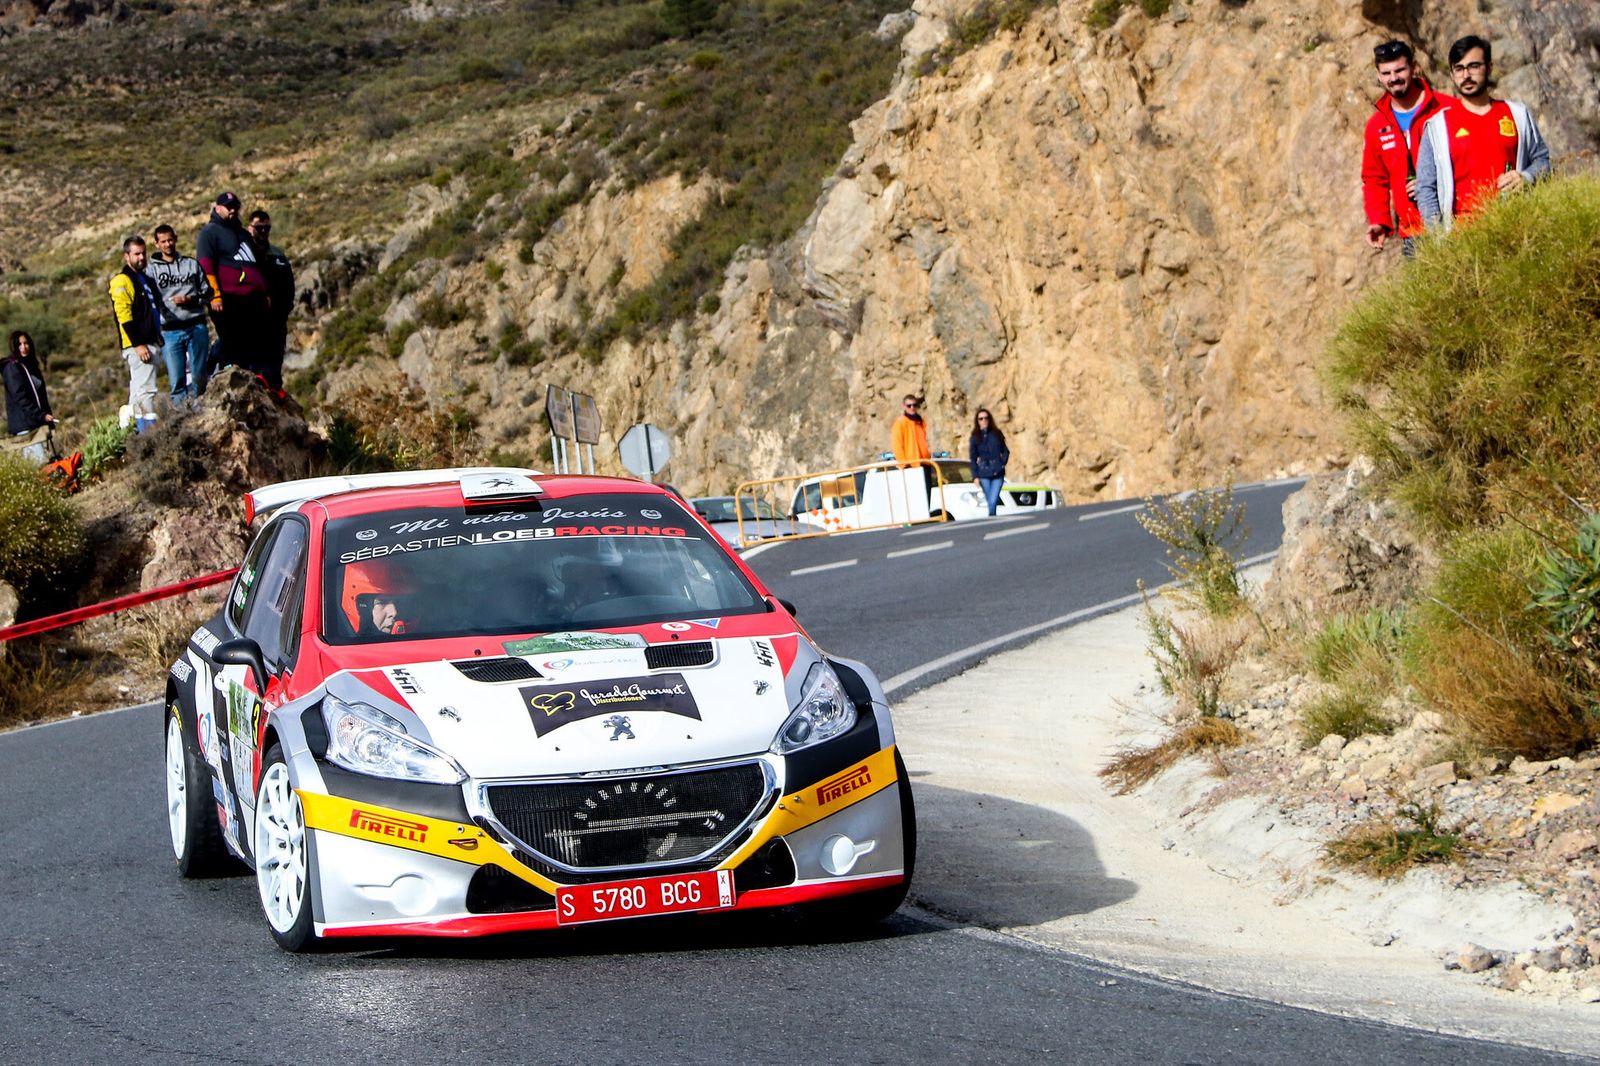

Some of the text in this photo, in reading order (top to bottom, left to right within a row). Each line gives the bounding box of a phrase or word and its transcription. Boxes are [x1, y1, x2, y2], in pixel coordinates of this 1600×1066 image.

[389, 507, 627, 534] Mi niño Jesús
[816, 765, 872, 806] PIRELLI
[349, 808, 428, 843] PIRELLI
[720, 875, 726, 884] X
[561, 879, 701, 917] S 5780 BCG
[721, 895, 730, 904] 22
